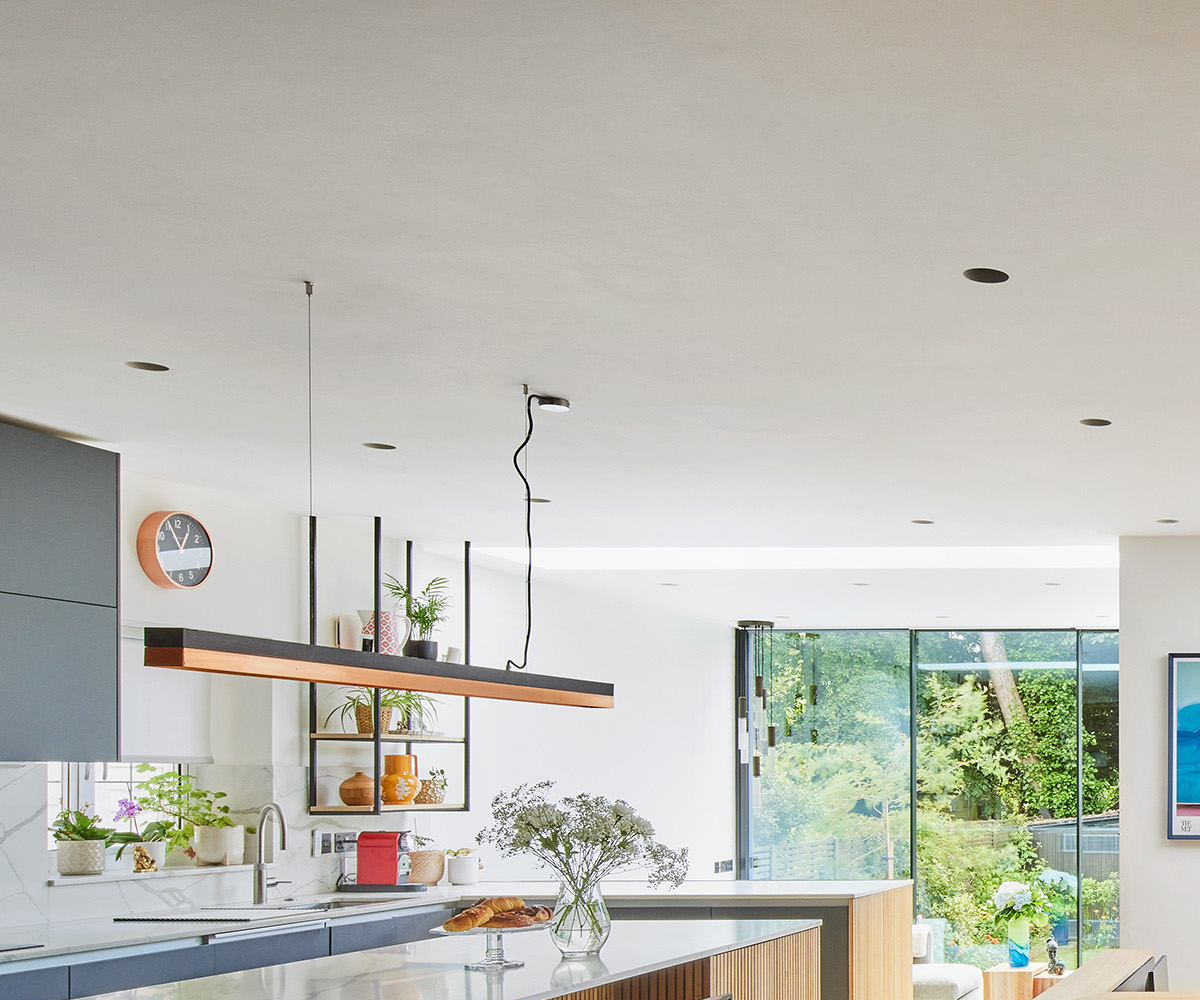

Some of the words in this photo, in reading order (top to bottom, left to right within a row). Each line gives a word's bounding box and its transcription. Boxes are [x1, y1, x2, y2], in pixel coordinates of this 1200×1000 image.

[174, 519, 181, 529] 12
[194, 534, 199, 543] 2
[179, 573, 184, 582] 6
[189, 571, 194, 580] 5
